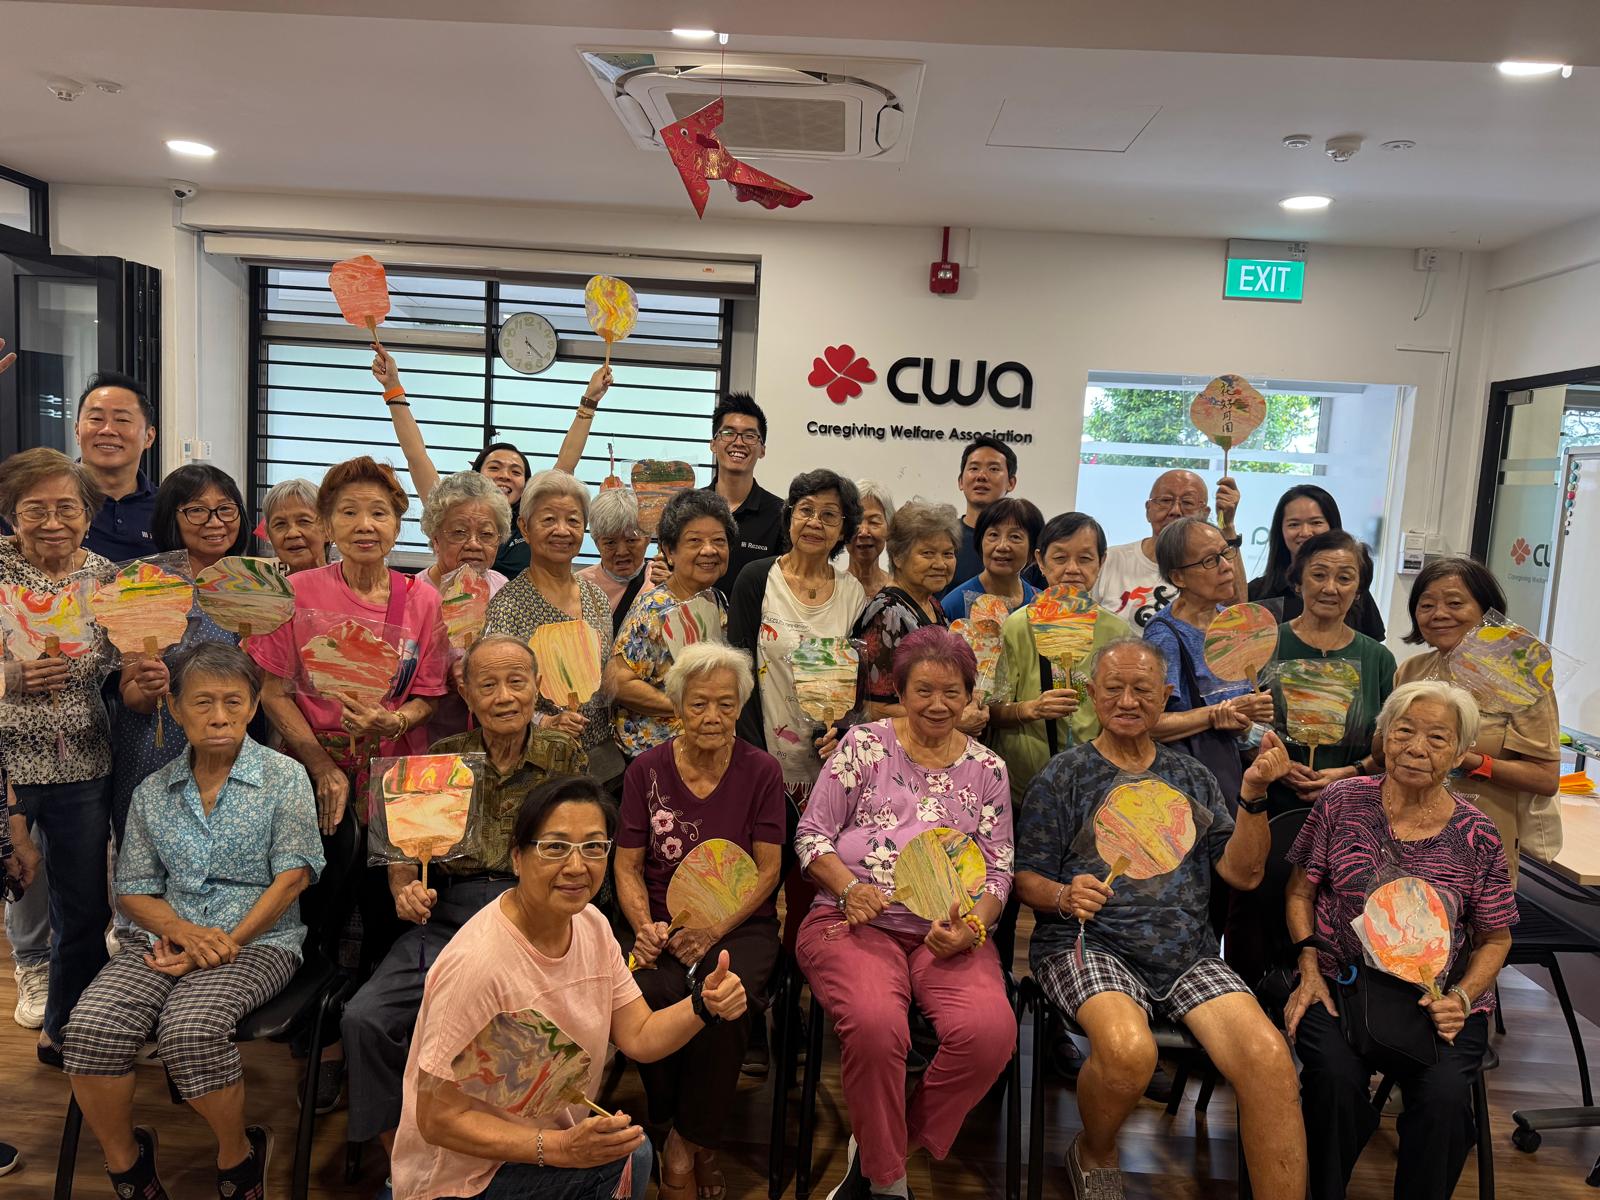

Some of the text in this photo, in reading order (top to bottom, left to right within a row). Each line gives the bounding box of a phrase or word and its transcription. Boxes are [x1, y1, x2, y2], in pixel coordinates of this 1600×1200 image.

[1239, 265, 1291, 293] EXIT
[807, 421, 885, 440] Caregiving
[890, 424, 944, 440] Welfare
